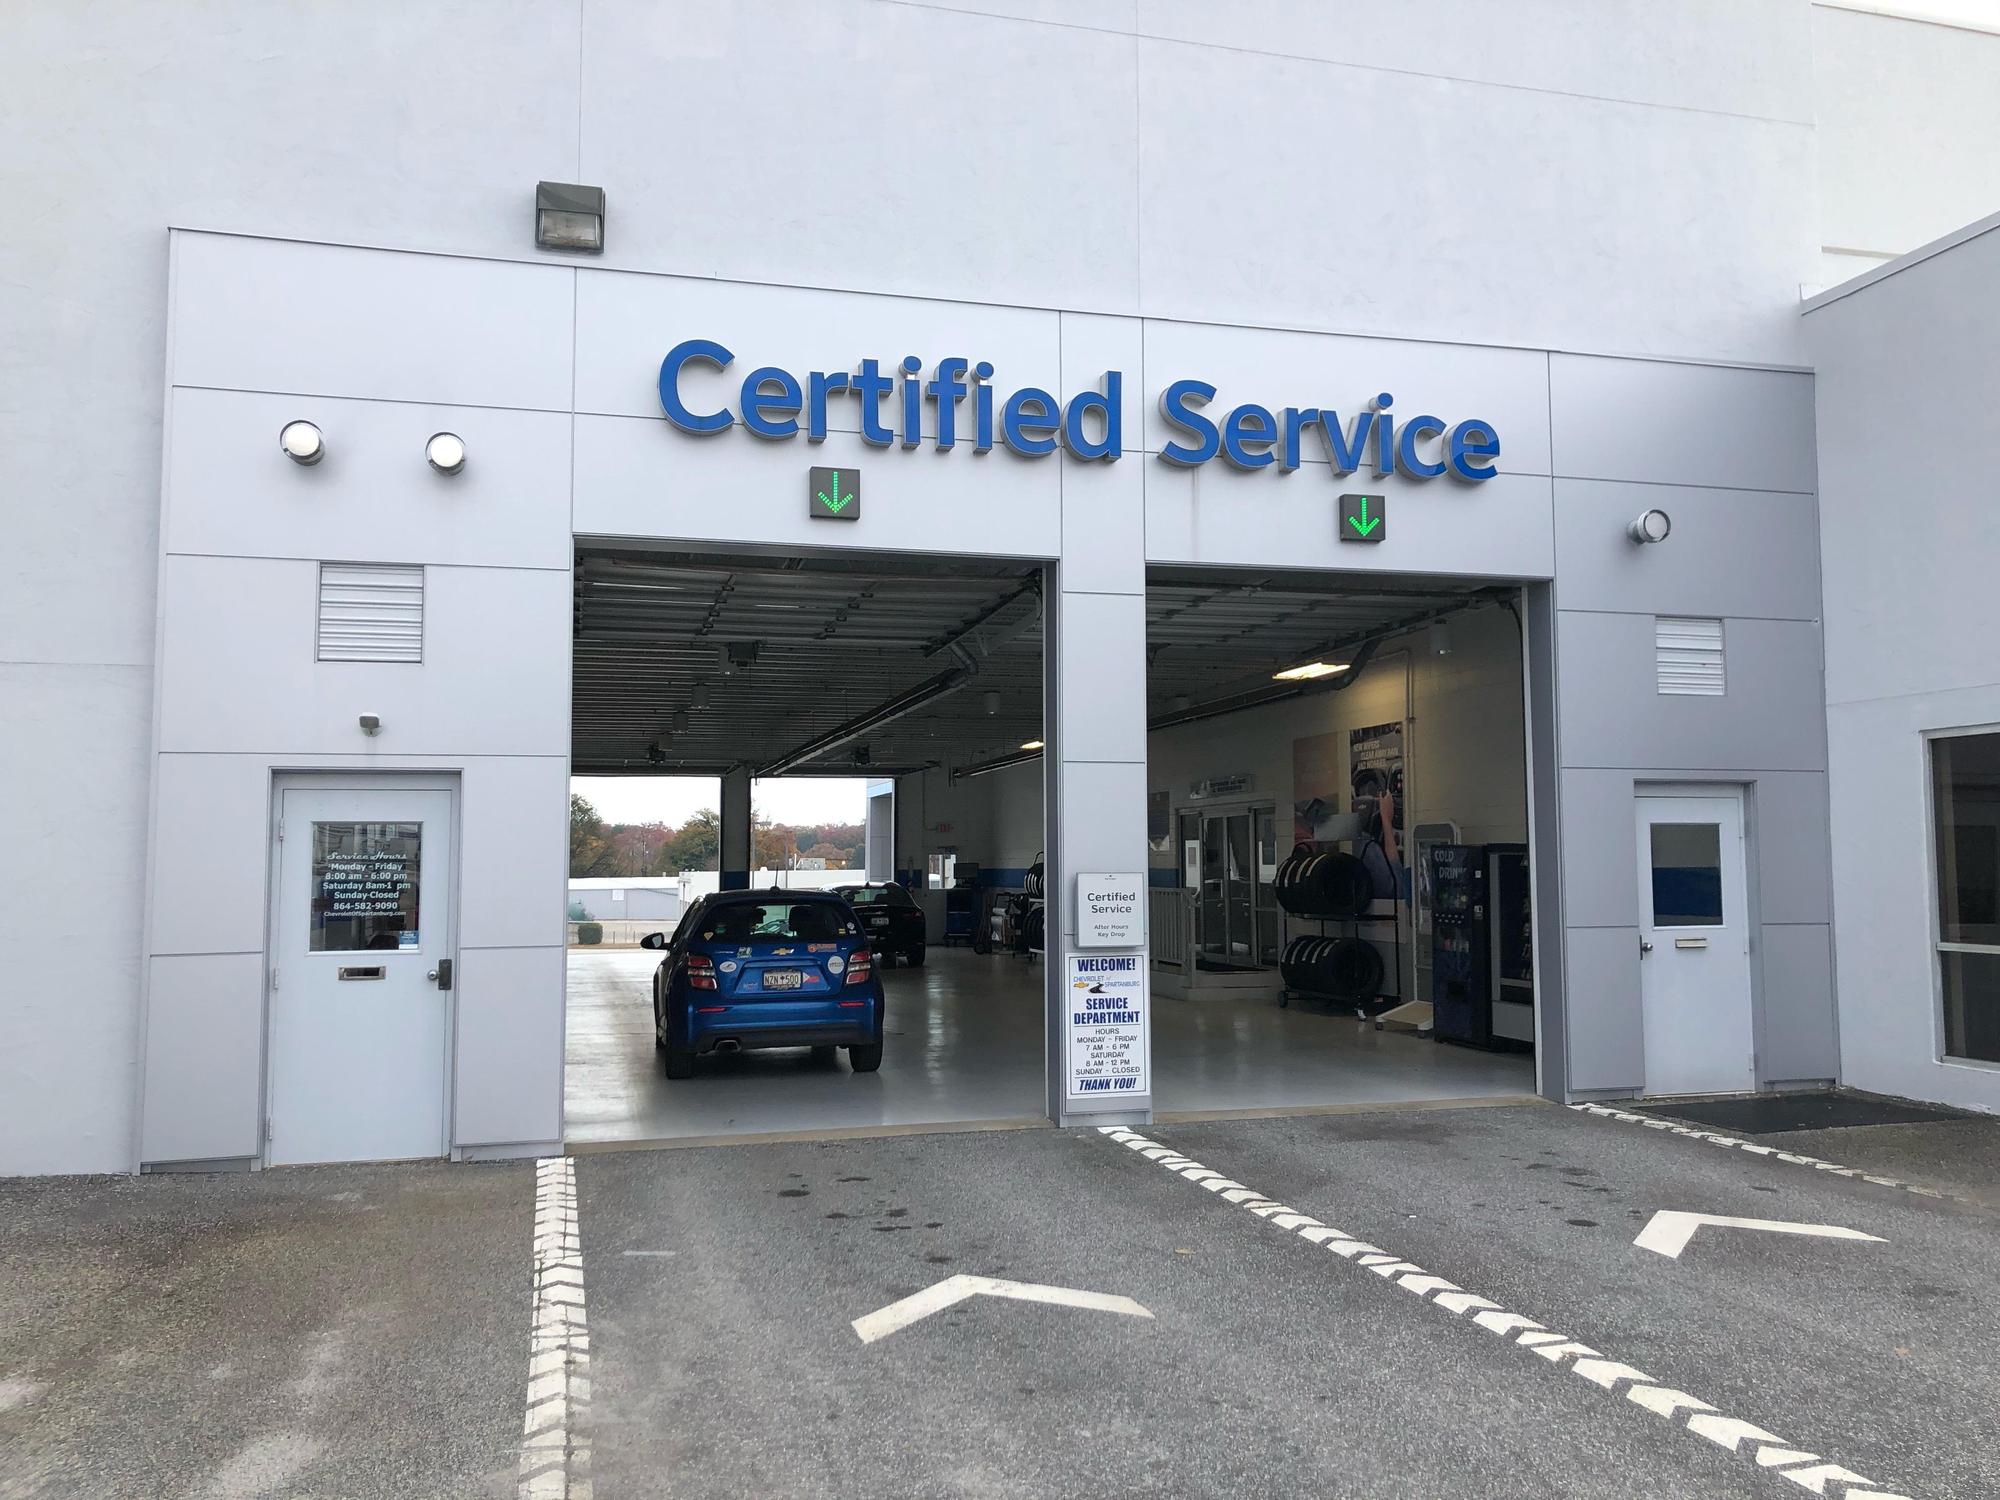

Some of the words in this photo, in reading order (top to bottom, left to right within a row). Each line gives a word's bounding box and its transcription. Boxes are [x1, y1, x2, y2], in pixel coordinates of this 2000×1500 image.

[657, 338, 1122, 463] Certified
[1156, 379, 1500, 484] Service
[327, 851, 369, 860] Service
[370, 850, 407, 860] Hours
[1434, 850, 1454, 862] COLD
[331, 863, 366, 871] Monday
[375, 862, 403, 871] Friday
[325, 872, 346, 880] 8:00
[371, 872, 391, 880] 6:00
[393, 873, 408, 881] pm
[323, 882, 363, 890] Saturday
[1087, 892, 1136, 902] Certified
[333, 902, 398, 910] 864-582-9090
[1091, 904, 1132, 914] Service
[1077, 958, 1136, 972] WELCOME!
[764, 975, 779, 985] NZN
[785, 974, 799, 985] 500
[1086, 997, 1129, 1010] SERVICE
[1073, 1011, 1140, 1025] DEPARTMENT
[1090, 1051, 1125, 1059] SATURDAY
[1111, 1066, 1141, 1074] CLOSED
[1079, 1078, 1112, 1091] THANK
[1113, 1077, 1137, 1090] YOU!
